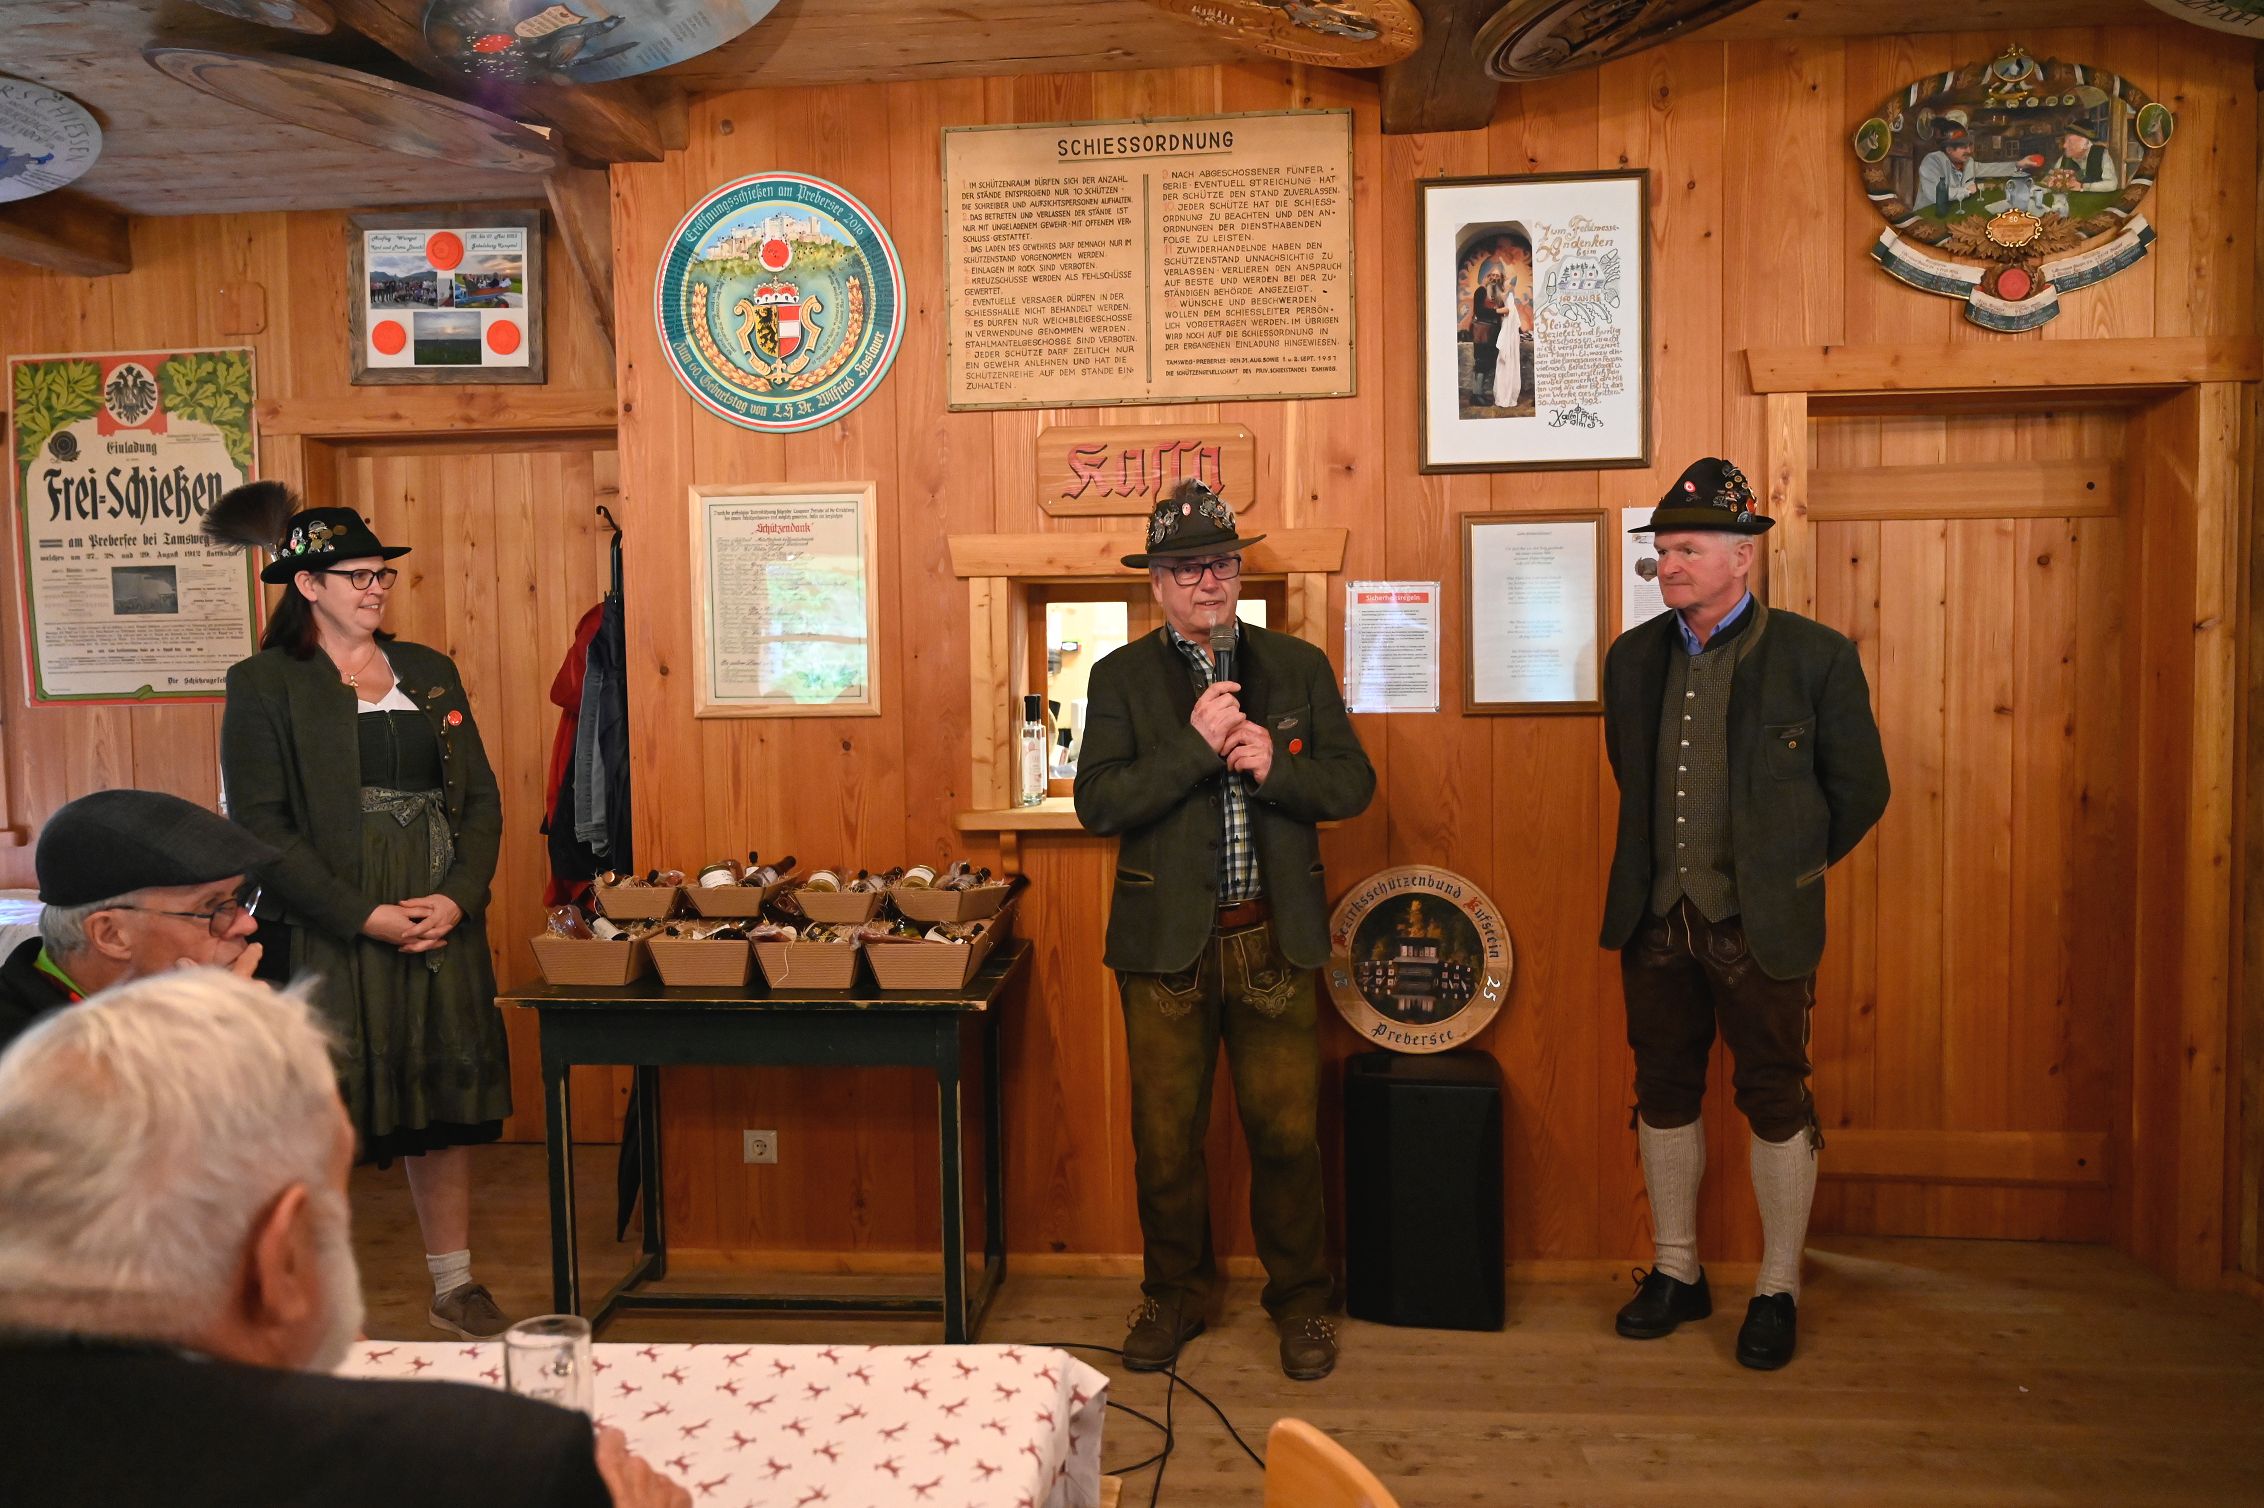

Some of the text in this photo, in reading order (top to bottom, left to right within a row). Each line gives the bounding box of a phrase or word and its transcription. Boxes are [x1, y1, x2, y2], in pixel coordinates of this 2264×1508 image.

[1058, 131, 1234, 157] SCHIESSORDNUNG
[778, 186, 792, 197] am
[796, 184, 844, 216] Prebersee
[843, 213, 866, 235] 2016
[673, 340, 692, 364] Zum
[700, 374, 748, 413] Geburtstag
[750, 404, 767, 416] von
[816, 376, 855, 408] Wilfried
[855, 331, 885, 378] Haslauer
[106, 439, 158, 455] Einladung
[68, 537, 83, 548] am
[143, 532, 157, 546] bei
[1462, 896, 1500, 959] Kufstein
[1483, 975, 1501, 1003] 25
[1370, 1022, 1454, 1047] Prebersee
